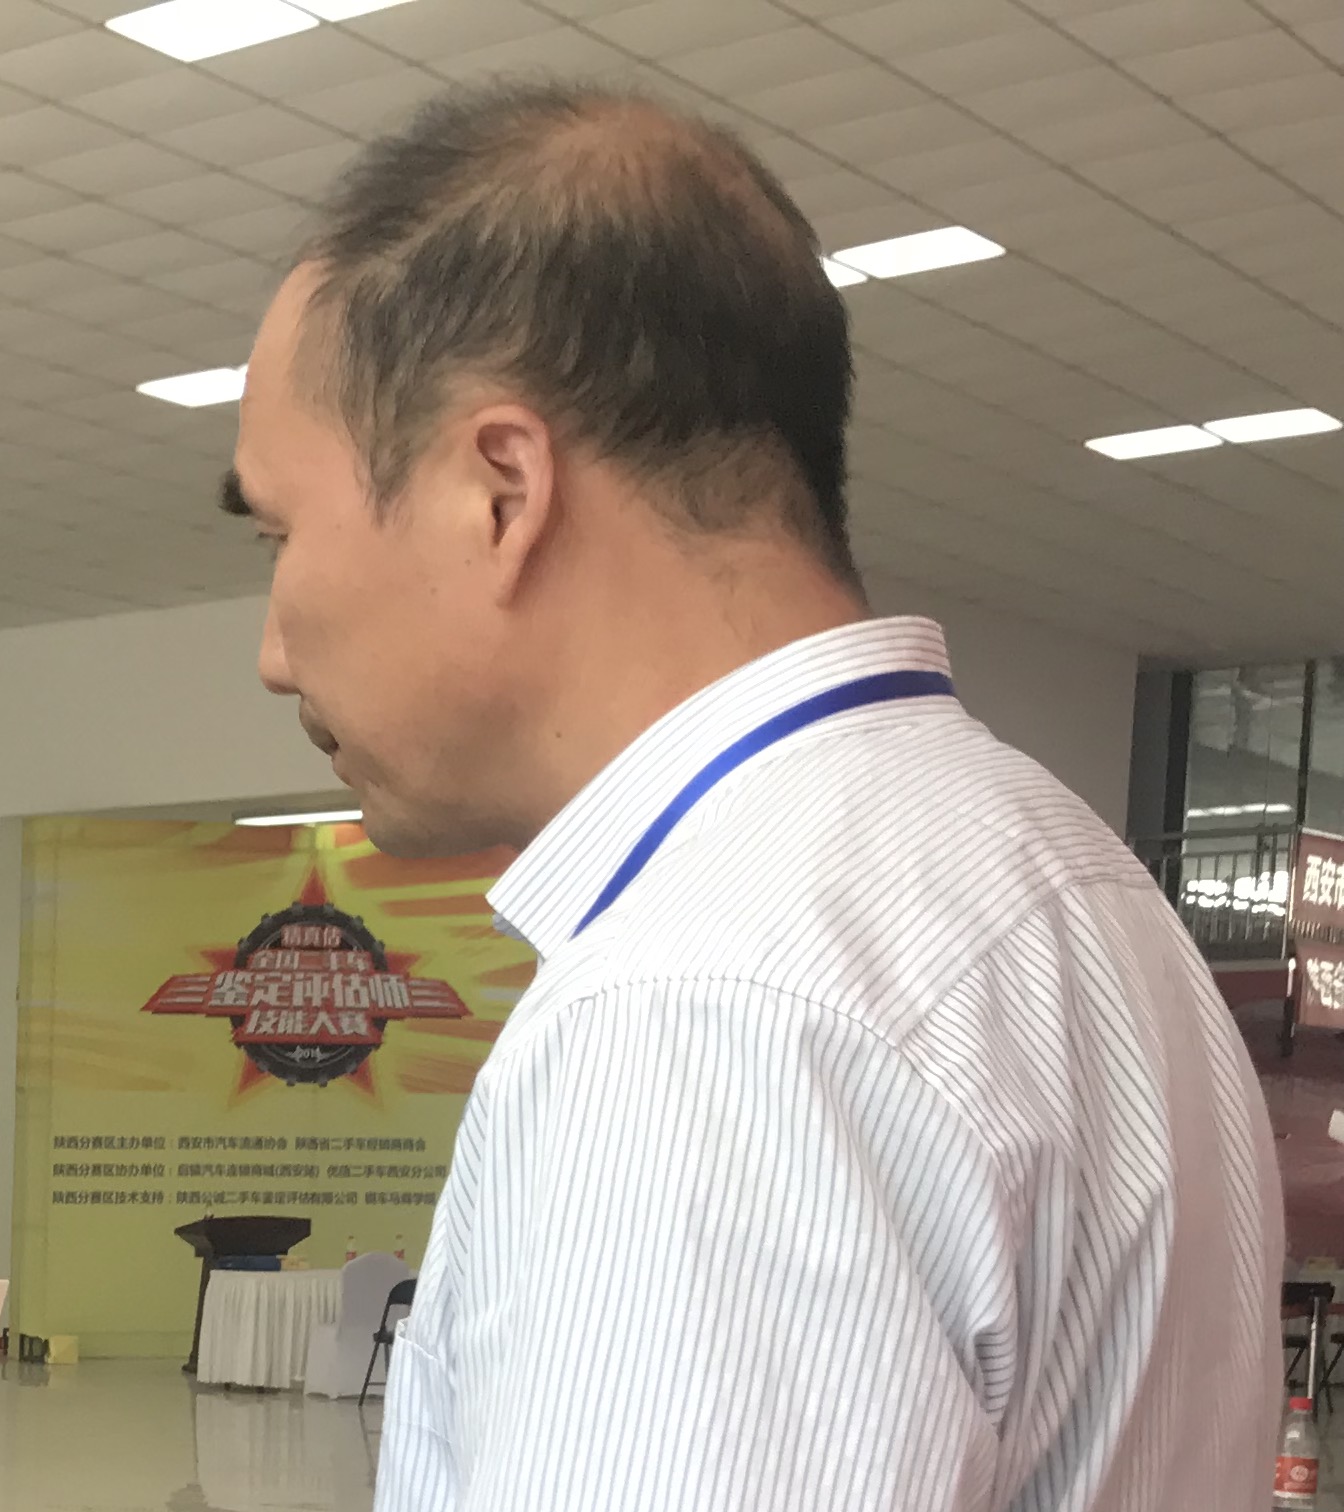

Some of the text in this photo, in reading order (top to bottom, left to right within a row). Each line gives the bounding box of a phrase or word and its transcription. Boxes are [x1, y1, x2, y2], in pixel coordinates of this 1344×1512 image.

[281, 925, 343, 947] 精真估
[249, 949, 373, 971] 全国二手车
[208, 971, 410, 1009] 鉴定评估师
[245, 1010, 369, 1037] 技能大赛
